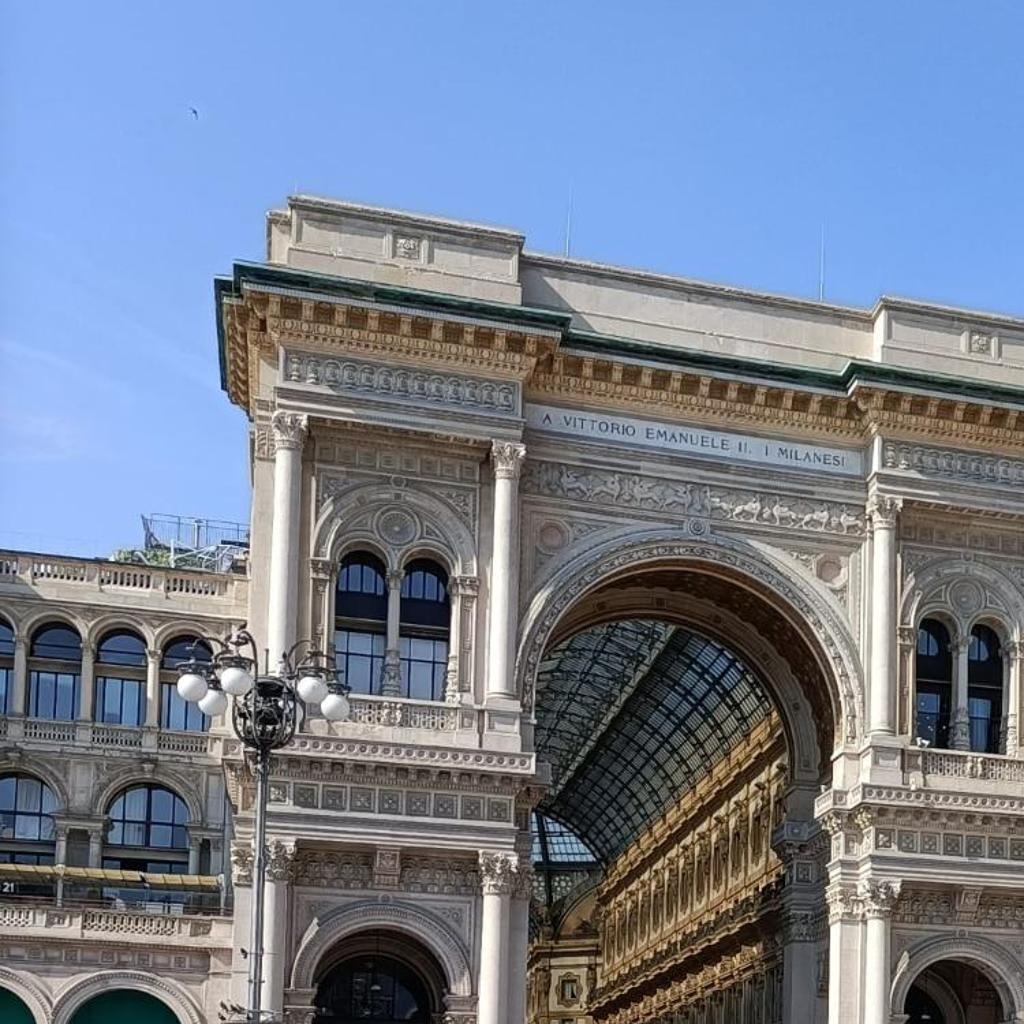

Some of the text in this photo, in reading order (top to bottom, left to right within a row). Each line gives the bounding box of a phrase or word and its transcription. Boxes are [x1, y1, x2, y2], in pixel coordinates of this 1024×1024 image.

[542, 413, 552, 424] A
[563, 415, 636, 437] VITTORIO
[645, 427, 730, 451] EMANUELE
[777, 447, 845, 467] MILANESI
[2, 882, 15, 893] 21
